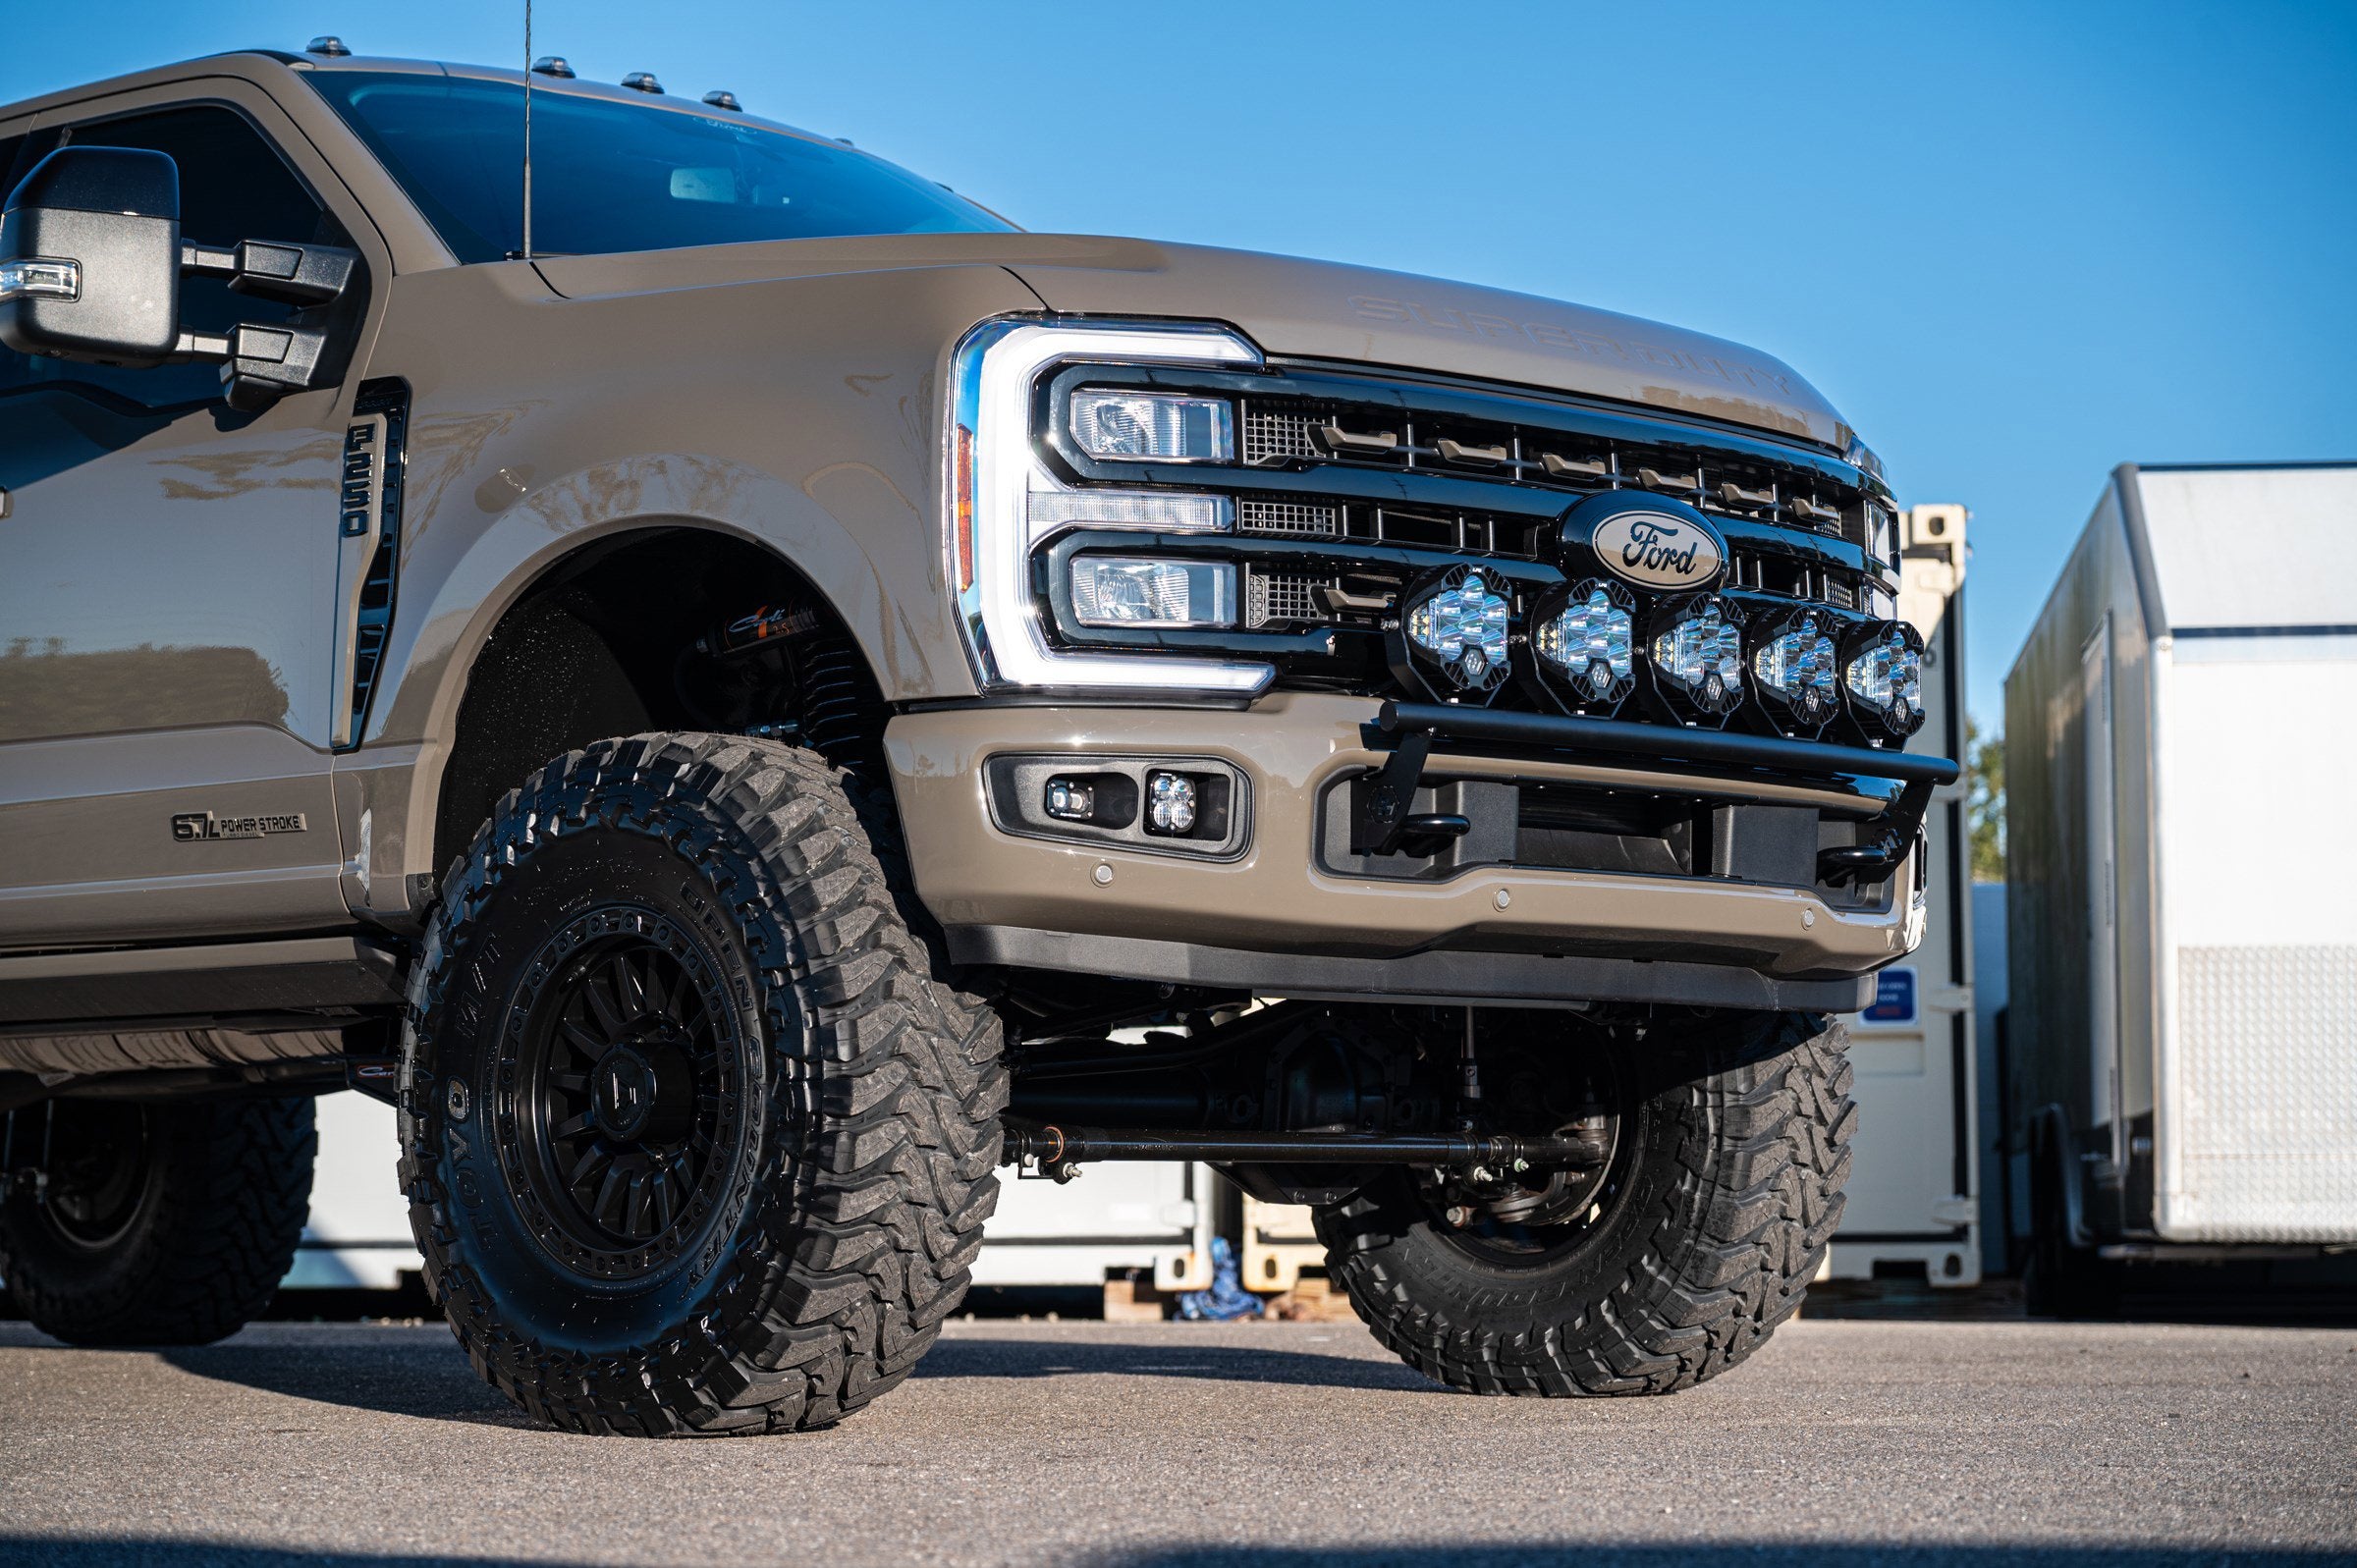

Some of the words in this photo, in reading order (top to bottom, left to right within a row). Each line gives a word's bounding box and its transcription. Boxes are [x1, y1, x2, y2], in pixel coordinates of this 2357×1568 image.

[1346, 295, 1628, 361] SUPER
[1631, 343, 1791, 396] DUTY
[1621, 520, 1698, 575] Ford
[221, 818, 256, 833] POWER
[258, 814, 301, 832] STROKE
[680, 880, 755, 1012] OPEN
[446, 1074, 500, 1253] TOYO
